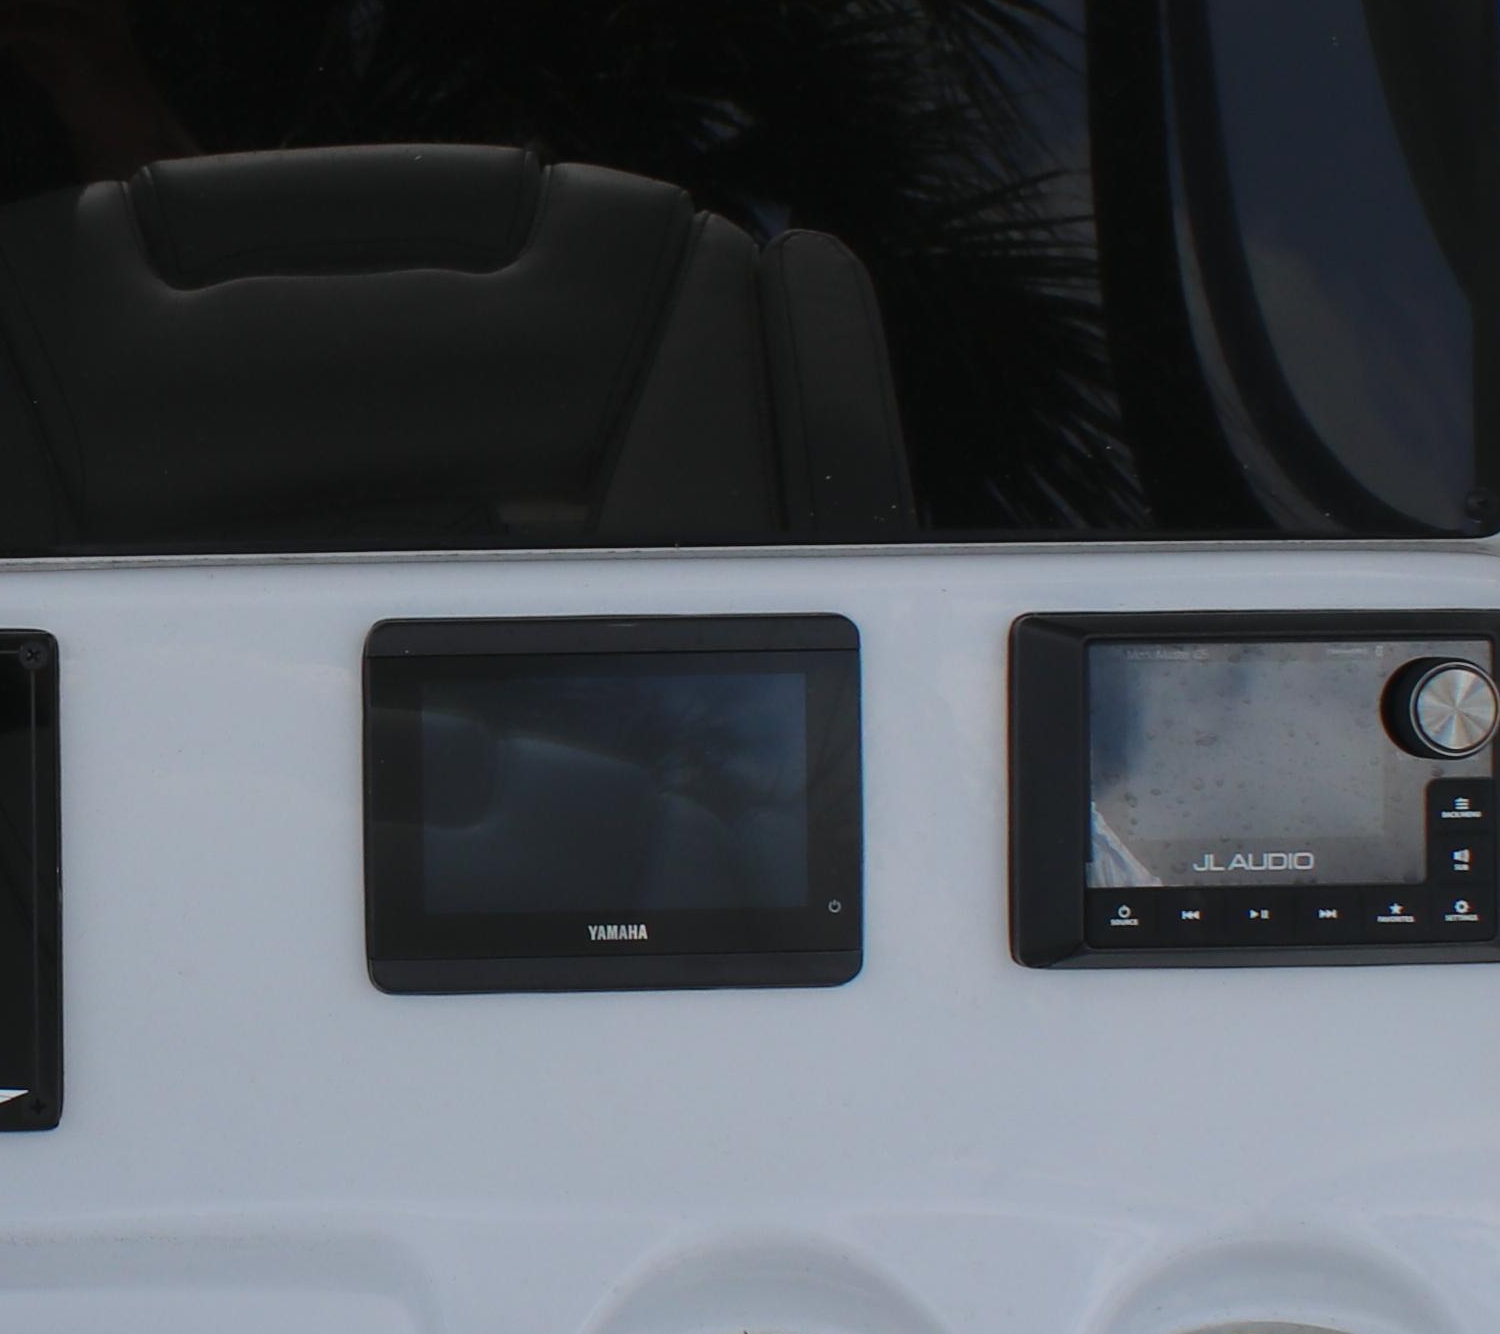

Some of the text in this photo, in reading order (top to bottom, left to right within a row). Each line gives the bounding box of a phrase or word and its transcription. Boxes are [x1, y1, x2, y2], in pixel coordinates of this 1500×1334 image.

[1193, 851, 1315, 871] JL AUDIO
[588, 924, 648, 940] YAMAHA
